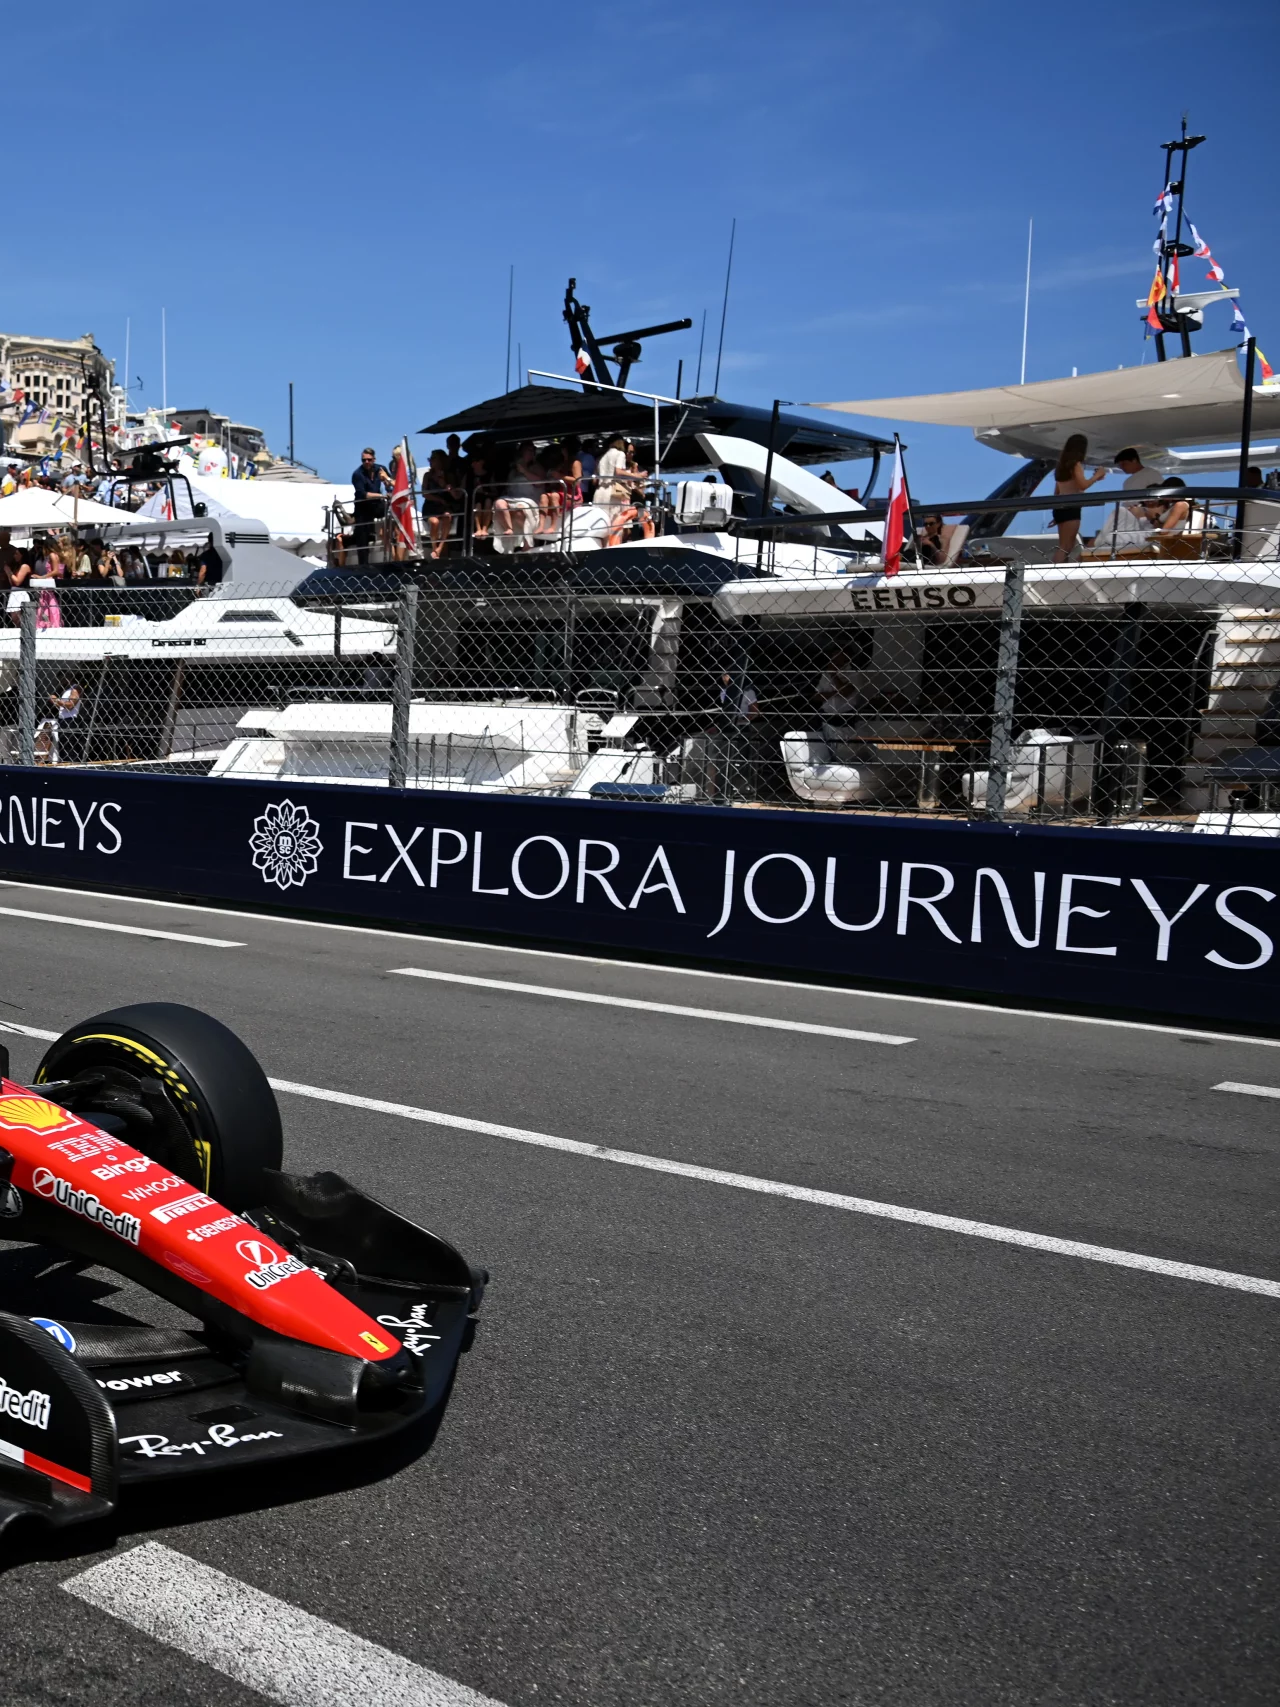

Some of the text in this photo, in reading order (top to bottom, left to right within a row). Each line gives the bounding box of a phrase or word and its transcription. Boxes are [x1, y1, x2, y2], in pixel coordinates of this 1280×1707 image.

[850, 586, 976, 610] EEHSO
[342, 821, 1277, 970] EXPLORA JOURNEYS
[47, 1129, 128, 1163] IBM
[54, 1179, 140, 1245] UniCredit
[118, 1423, 284, 1458] Ray-Ban
